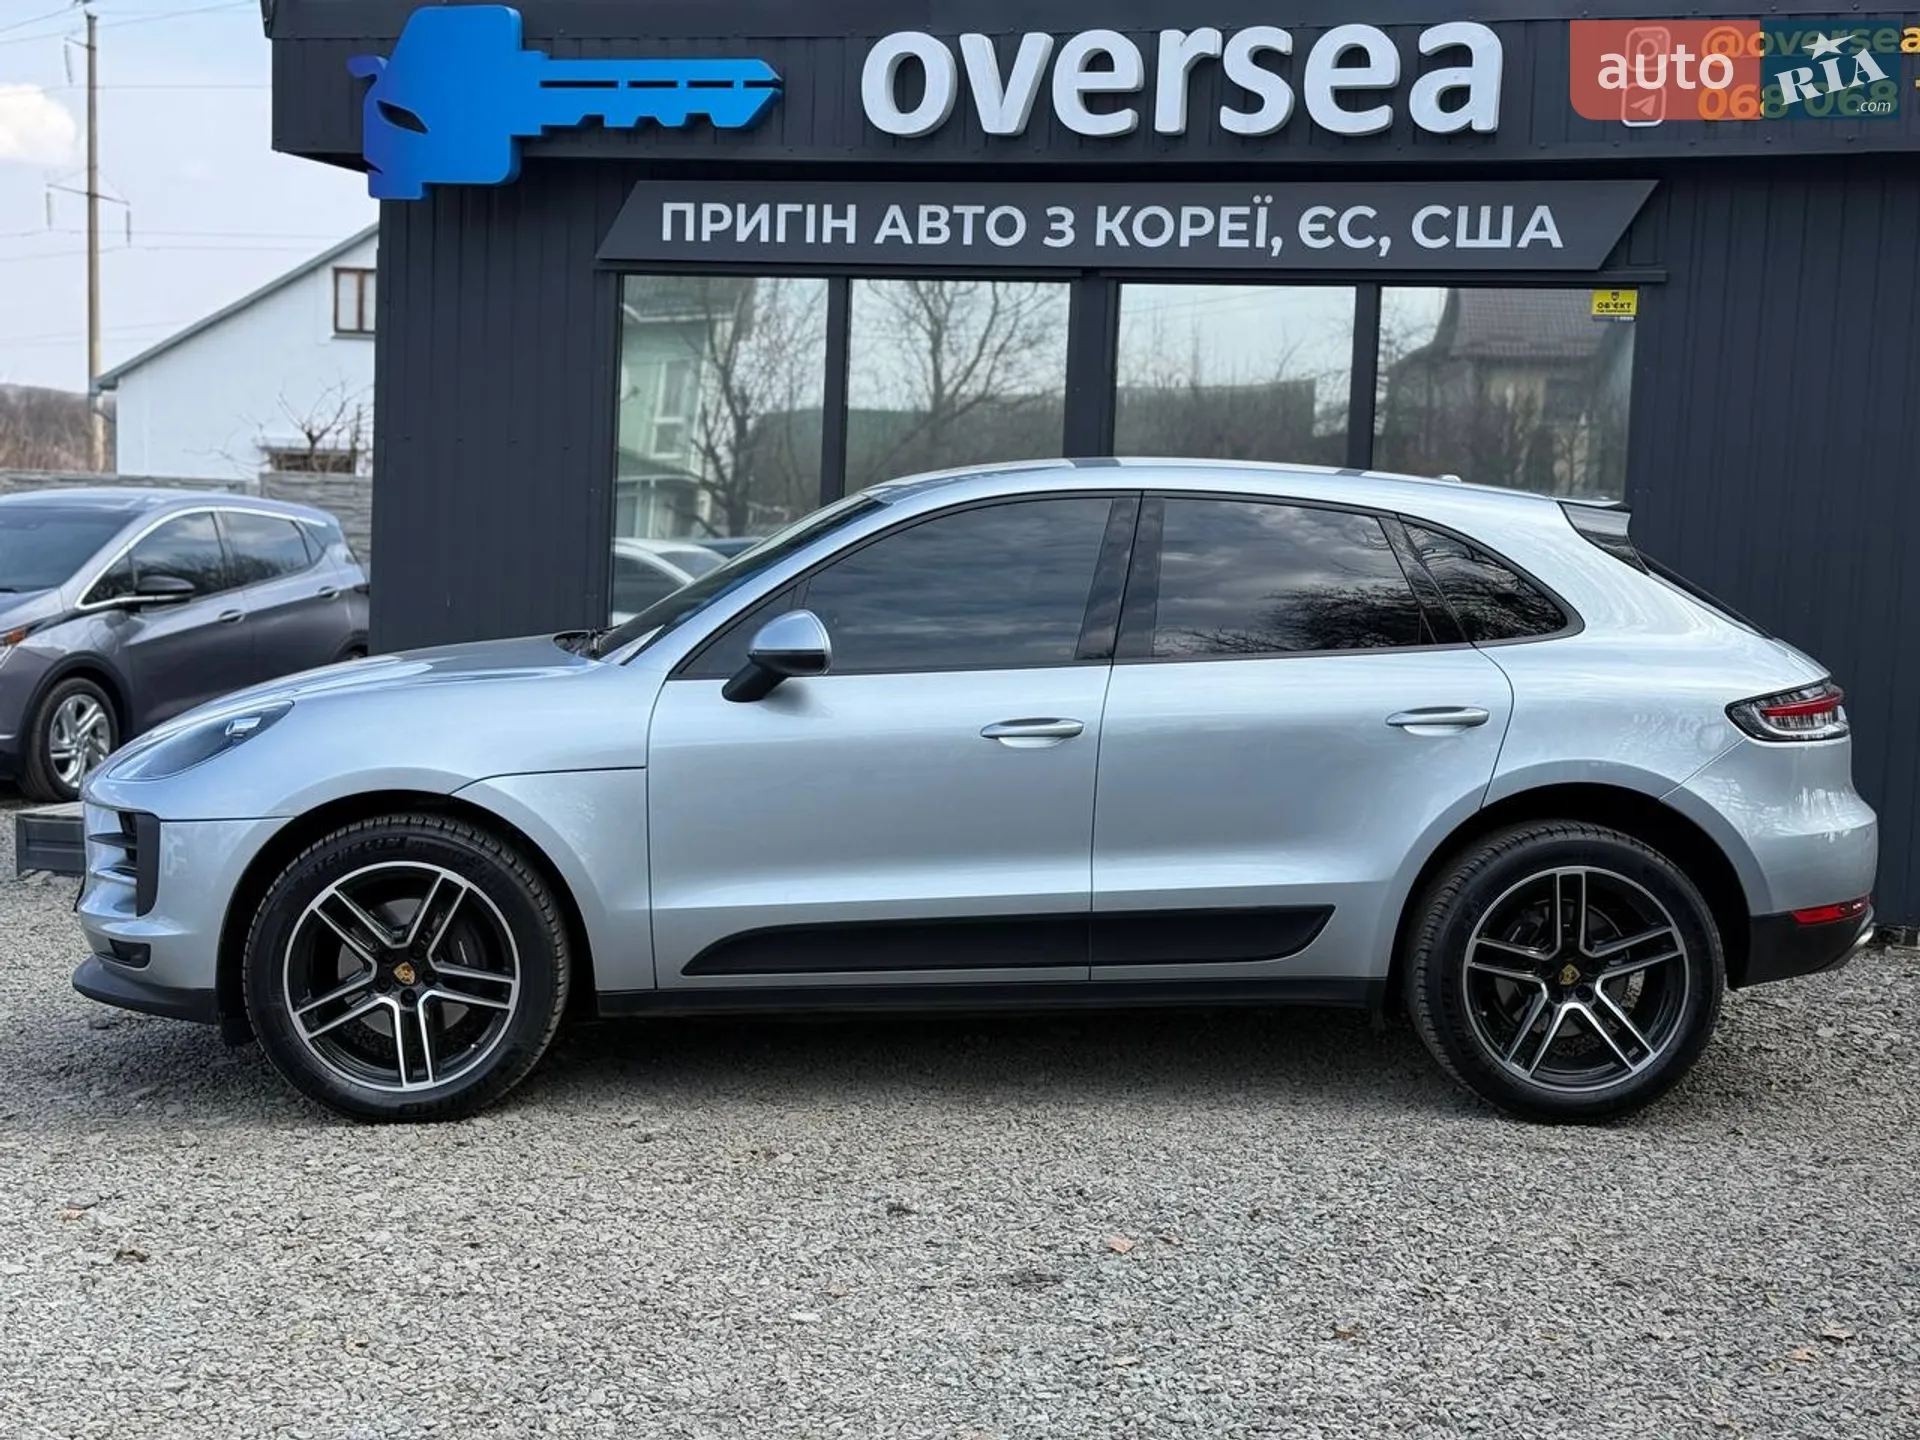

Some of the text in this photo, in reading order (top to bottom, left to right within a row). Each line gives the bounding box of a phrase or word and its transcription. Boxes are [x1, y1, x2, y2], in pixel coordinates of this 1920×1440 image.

[861, 22, 1502, 137] oversea
[1698, 83, 1789, 121] 068
[661, 195, 1564, 257] ПРИГІН АВТО З КОРЕЇ, ЄС, США
